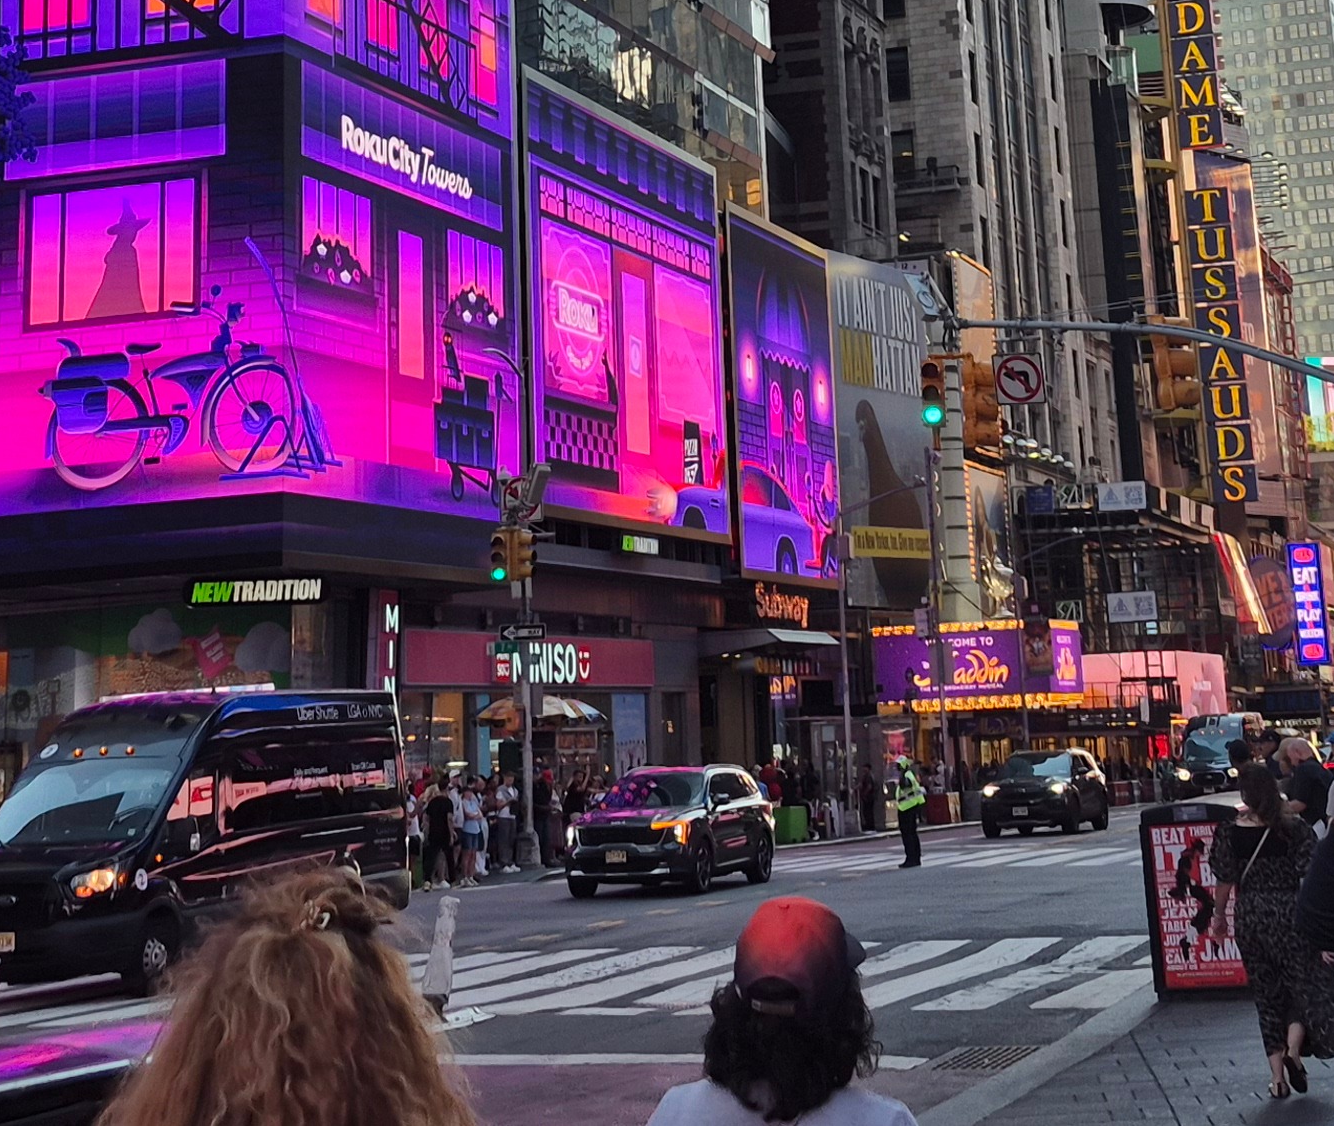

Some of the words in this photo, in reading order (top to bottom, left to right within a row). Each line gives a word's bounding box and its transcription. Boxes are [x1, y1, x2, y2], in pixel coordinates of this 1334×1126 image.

[836, 276, 849, 327] IT
[852, 276, 887, 336] AIN'T
[1193, 189, 1247, 503] TUSSAUDS
[1292, 567, 1318, 585] EAT
[1297, 609, 1322, 622] PLAY
[979, 636, 994, 646] TO
[368, 704, 383, 718] NYC
[1151, 827, 1186, 845] BEAT
[1161, 908, 1199, 919] JEAN
